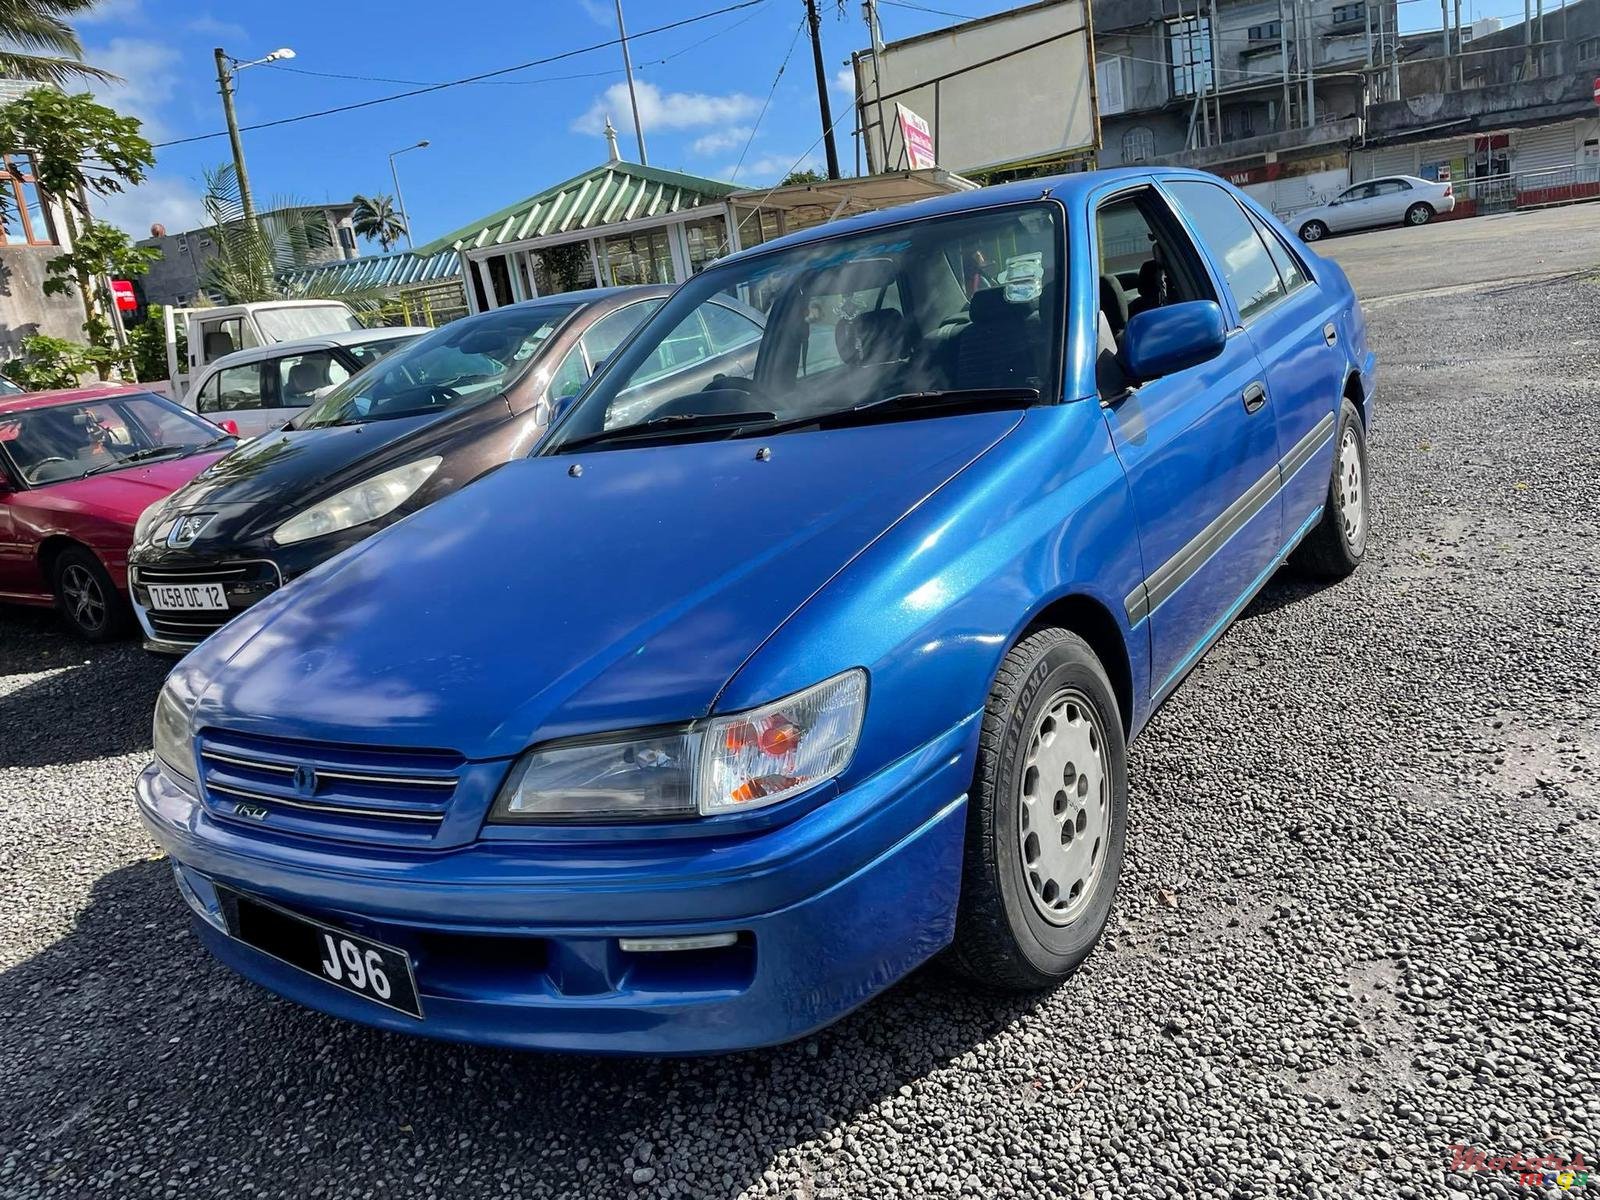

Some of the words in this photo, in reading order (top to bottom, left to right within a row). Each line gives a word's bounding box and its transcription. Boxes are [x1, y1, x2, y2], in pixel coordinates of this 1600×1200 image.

[151, 588, 184, 608] 7458
[205, 586, 223, 607] 12
[321, 934, 392, 999] J96
